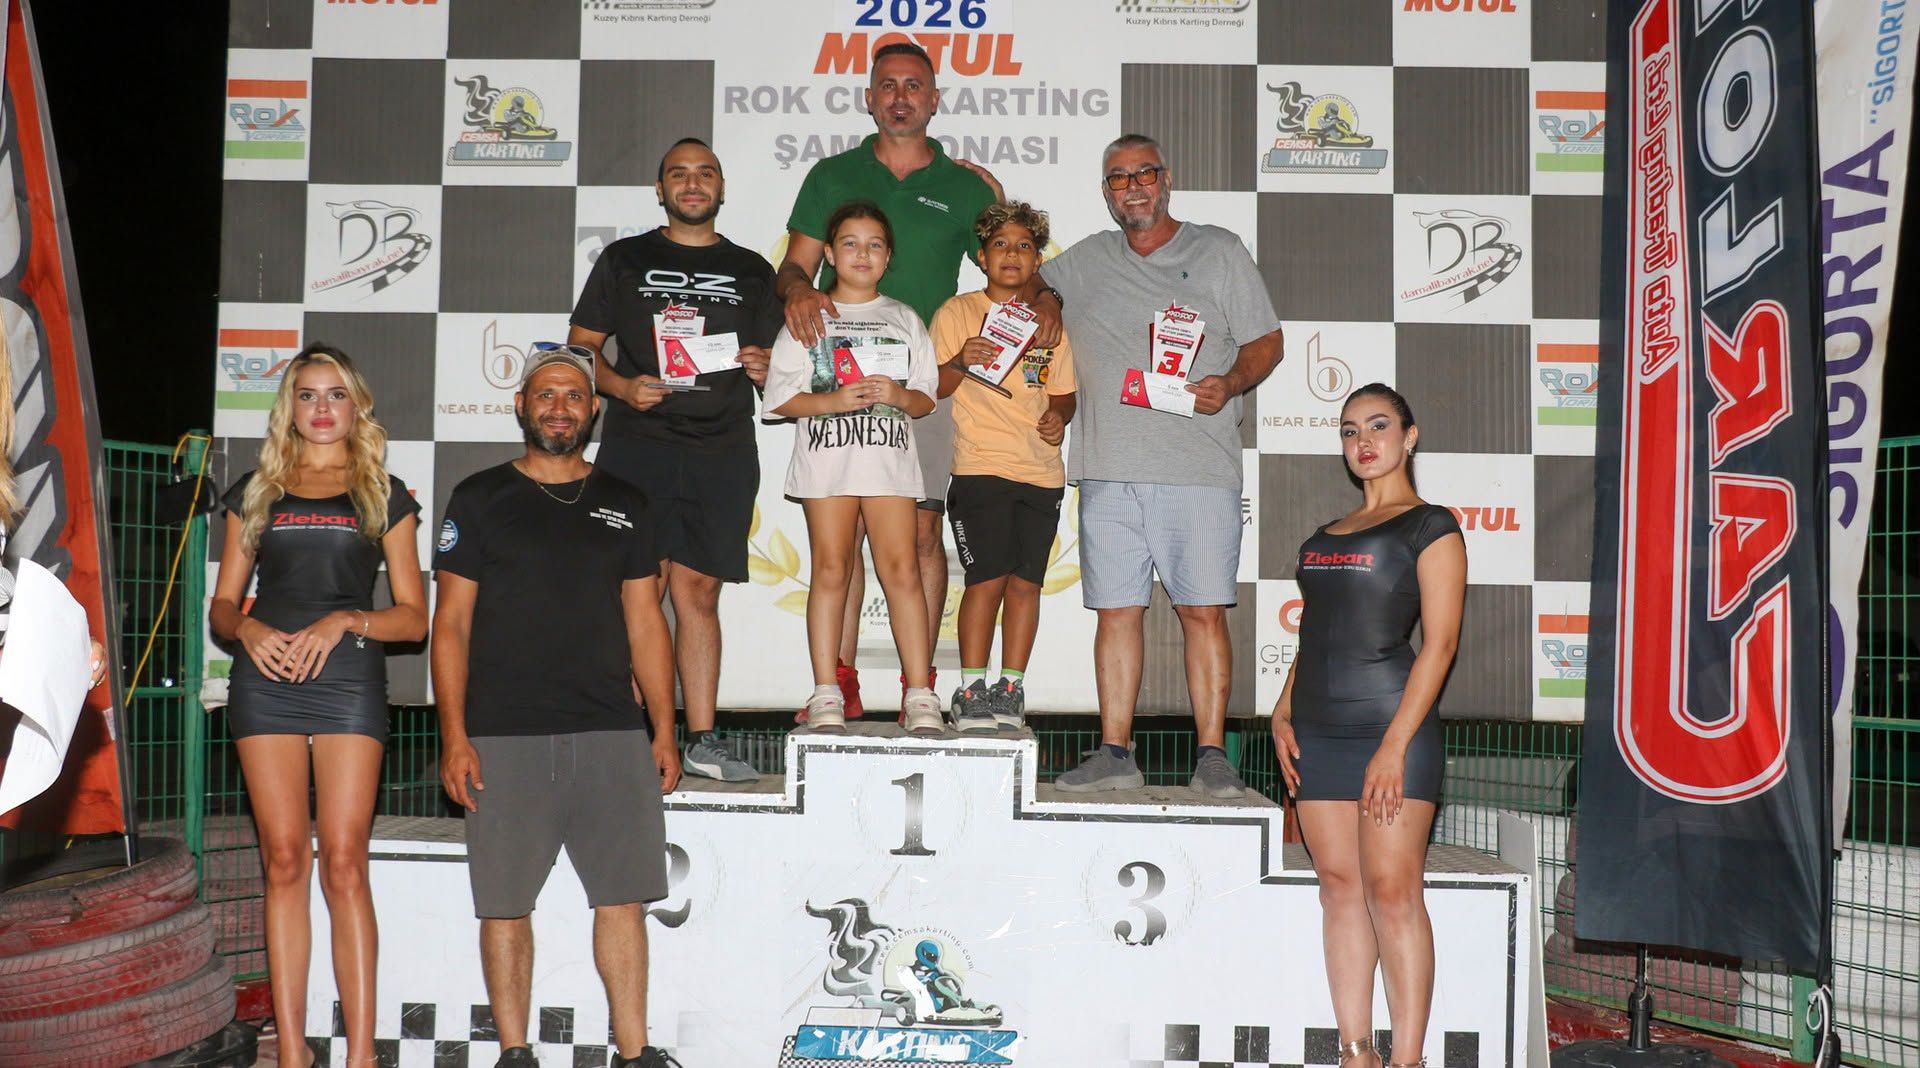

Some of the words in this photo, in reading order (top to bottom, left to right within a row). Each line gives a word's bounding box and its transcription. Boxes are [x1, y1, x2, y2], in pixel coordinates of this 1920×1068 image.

[855, 0, 987, 29] 2026
[1180, 18, 1210, 27] Karting
[724, 85, 809, 114] ROK
[832, 85, 874, 114] CU
[474, 143, 545, 159] KARTING
[1276, 139, 1314, 149] CEMSA
[1289, 150, 1361, 166] KARTING
[643, 291, 738, 305] RACING
[438, 405, 478, 415] NEAR
[483, 405, 515, 415] EAS
[1262, 416, 1304, 427] NEAR
[1309, 417, 1340, 428] EAS
[1450, 507, 1520, 531] TUL
[955, 520, 967, 543] NIKE
[960, 543, 974, 566] AIR
[1303, 552, 1375, 567] Ziebart
[890, 772, 937, 857] 1
[1113, 860, 1167, 946] 3
